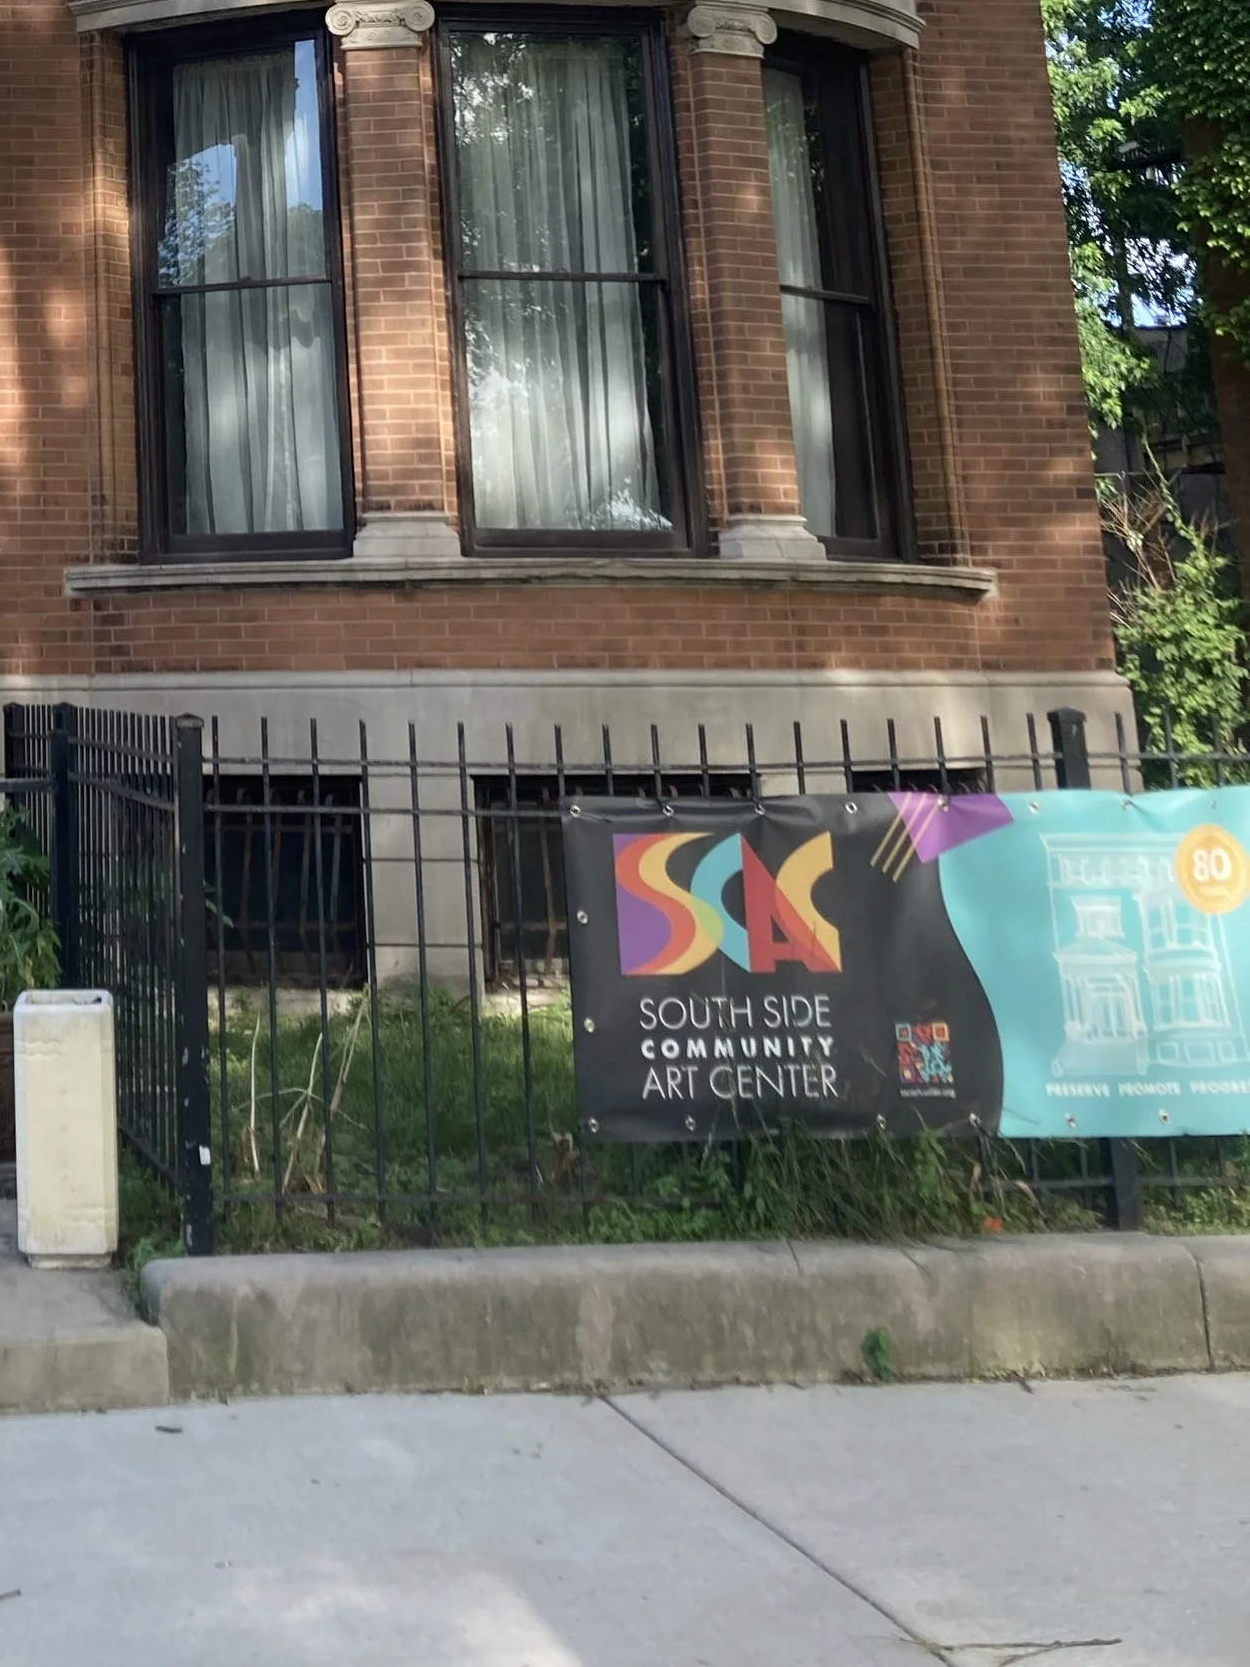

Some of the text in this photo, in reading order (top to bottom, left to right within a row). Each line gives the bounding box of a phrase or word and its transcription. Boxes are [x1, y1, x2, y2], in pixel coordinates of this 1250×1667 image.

[1192, 846, 1232, 883] 80
[639, 993, 832, 1030] SOUTH SIDE
[640, 1035, 834, 1060] COMMUNITY
[642, 1063, 838, 1100] ART CENTER
[1045, 1082, 1111, 1098] PRESERVE
[1117, 1080, 1182, 1097] PROMOTE
